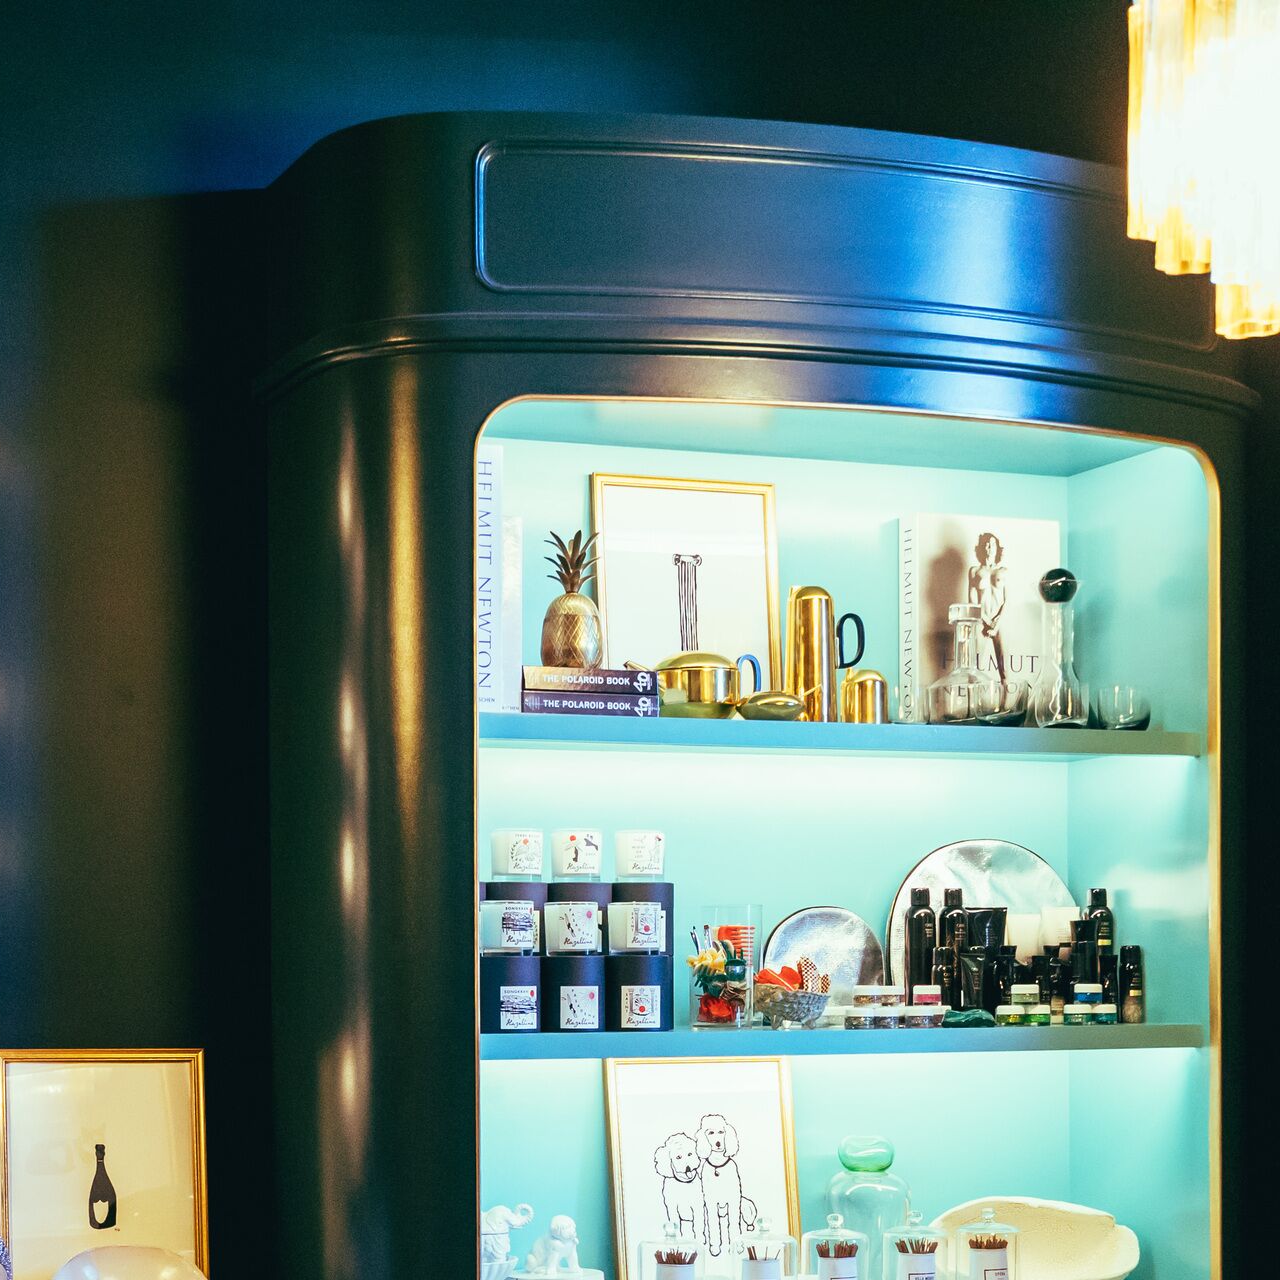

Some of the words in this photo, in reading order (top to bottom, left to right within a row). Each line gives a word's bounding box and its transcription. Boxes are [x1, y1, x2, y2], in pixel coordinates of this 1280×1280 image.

[478, 461, 492, 565] HELMUT
[478, 577, 492, 689] NEWTON
[942, 653, 1039, 673] HLMUT
[543, 674, 561, 682] THE
[561, 674, 605, 685] POLAROID
[606, 676, 631, 685] BOOK
[543, 699, 560, 708] THE
[562, 700, 605, 709] POLAROID
[607, 701, 631, 710] BOOK
